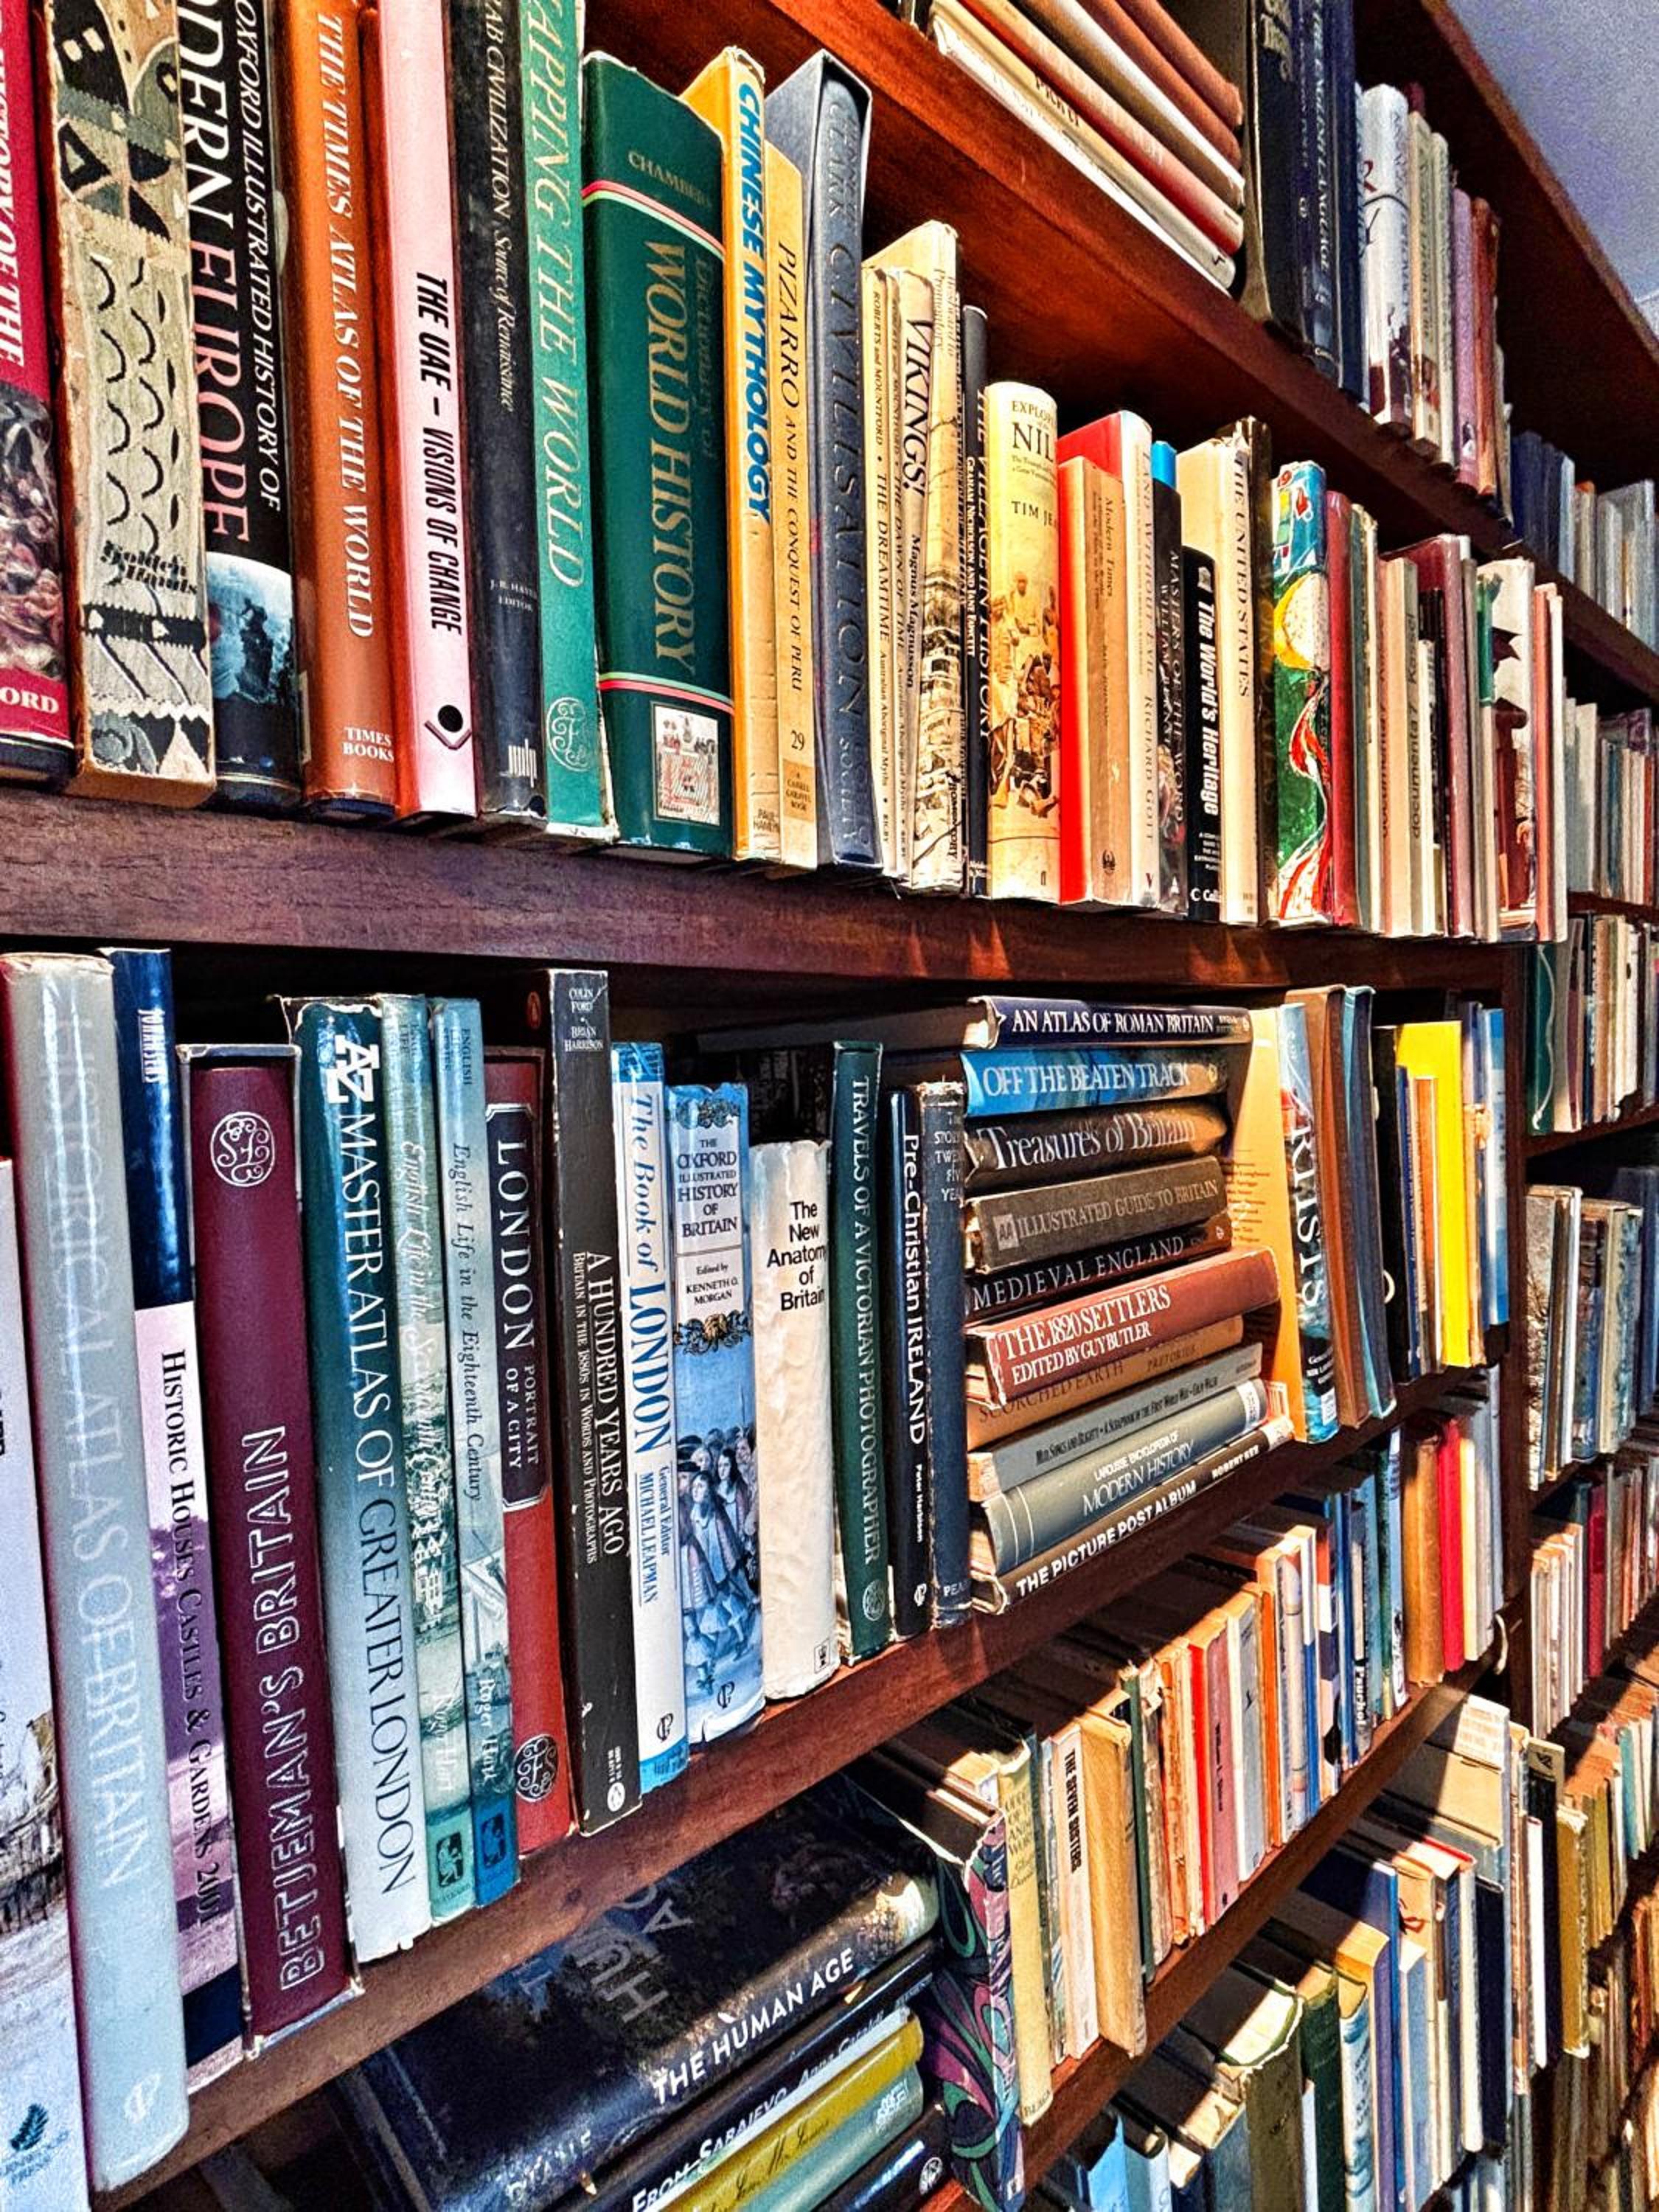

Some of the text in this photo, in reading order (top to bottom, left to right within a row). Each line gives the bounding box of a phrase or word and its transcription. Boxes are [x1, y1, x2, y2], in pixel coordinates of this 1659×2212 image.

[1315, 59, 1326, 156] ENGLISH
[235, 0, 280, 512] OXFORD ILLUSTRATED HISTORY OF
[1317, 161, 1329, 273] LANGUAGE
[317, 13, 375, 637] THE TIMES ATLAS OF THE WORLD
[738, 80, 771, 524] CHINESE MYTHOLOGY
[904, 319, 932, 498] VIKINGS!
[417, 272, 462, 634] THE UAE VISIONS OF CHANGE
[644, 241, 695, 675] WORLD HISTORY
[827, 243, 864, 717] CIVILISATION
[967, 456, 975, 502] GRAHAM
[778, 241, 806, 751] PIZARRO AND THE CONQUEST OF PERU 29
[967, 505, 975, 562] NICHOLSON
[906, 535, 922, 689] Magnus Magnusson
[967, 566, 975, 588] AND
[1234, 456, 1252, 698] THE UNITED STATES
[967, 614, 975, 656] FAWCETT
[1197, 601, 1216, 638] The
[1406, 612, 1417, 685] Kassel
[1170, 550, 1184, 821] MASTERS OF THE WORD
[1199, 643, 1217, 722] World's
[342, 742, 394, 762] BOOKS
[345, 727, 390, 745] TIMES
[1200, 726, 1220, 815] Heritage
[1408, 720, 1421, 838] documenta
[568, 987, 594, 1001] COLIN
[571, 1001, 594, 1012] FORD
[1013, 1010, 1037, 1032] AN
[1043, 1011, 1091, 1033] ATLAS
[1092, 1013, 1111, 1032] OF
[1115, 1014, 1164, 1033] ROMAN
[1166, 1015, 1214, 1033] BRITAIN
[462, 1029, 472, 1085] ENGLISH
[564, 1038, 603, 1051] HARRISON
[983, 1062, 1190, 1097] OFF THE BEATEN TRACK
[631, 1091, 653, 1154] The
[677, 1152, 737, 1169] OXFORD
[700, 1138, 718, 1149] THE
[978, 1112, 1196, 1170] Treasures of Britain
[340, 1114, 383, 1280] MASTER
[635, 1159, 655, 1234] Book
[678, 1169, 737, 1183] ILLUSTRATED
[678, 1183, 738, 1203] HISTORY
[703, 1203, 720, 1216] OF
[790, 1202, 818, 1220] The
[1018, 1201, 1113, 1239] ILLUSTRATED
[1116, 1195, 1155, 1217] GUIDE
[1158, 1190, 1173, 1207] TO
[1177, 1180, 1219, 1203] BRITAIN
[498, 1138, 535, 1349] LONDON
[637, 1242, 658, 1272] of
[682, 1217, 738, 1238] BRITAIN
[789, 1222, 819, 1242] New
[695, 1291, 732, 1305] MORGAN
[781, 1288, 825, 1311] Britain
[799, 1267, 814, 1285] of
[903, 1134, 926, 1444] Pre-Christian IRELAND
[973, 1236, 1183, 1310] MEDIEVAL ENGLAND
[347, 1284, 392, 1419] ATLAS
[453, 1143, 484, 1502] English Life in the Eighteenth Century
[852, 1075, 880, 1565] TRAVELS OF A VICTORIAN PHOTOGRAPHER
[998, 1285, 1172, 1360] THE 1820 SETTLERS
[1012, 1323, 1151, 1385] EDITED BY GUY BUTLER
[585, 1251, 625, 1554] A HUNDRED YEARS AGO
[630, 1280, 672, 1454] LONDON
[162, 1349, 188, 1476] HISTORIC
[506, 1369, 523, 1469] OF A CITY
[525, 1363, 539, 1464] PORTRAIT
[355, 1429, 395, 1488] OF
[1082, 1439, 1194, 1516] MODERN HISTORY
[171, 1479, 195, 1582] HOUSES
[639, 1471, 658, 1604] MICHAEL LEAPMAN
[1016, 1481, 1197, 1596] THE PICTURE POST ALBUM
[357, 1498, 403, 1694] GREATER
[176, 1588, 204, 1700] CASTLES
[185, 1709, 211, 1732] &
[242, 1426, 326, 1992] BETJEMAN'S BRITAIN
[187, 1740, 216, 1860] GARDENS
[371, 1695, 414, 1895] LONDON
[1065, 1748, 1082, 1874] THE SEVEN SISTERS
[653, 1947, 855, 2107] THE HUMAN AGE
